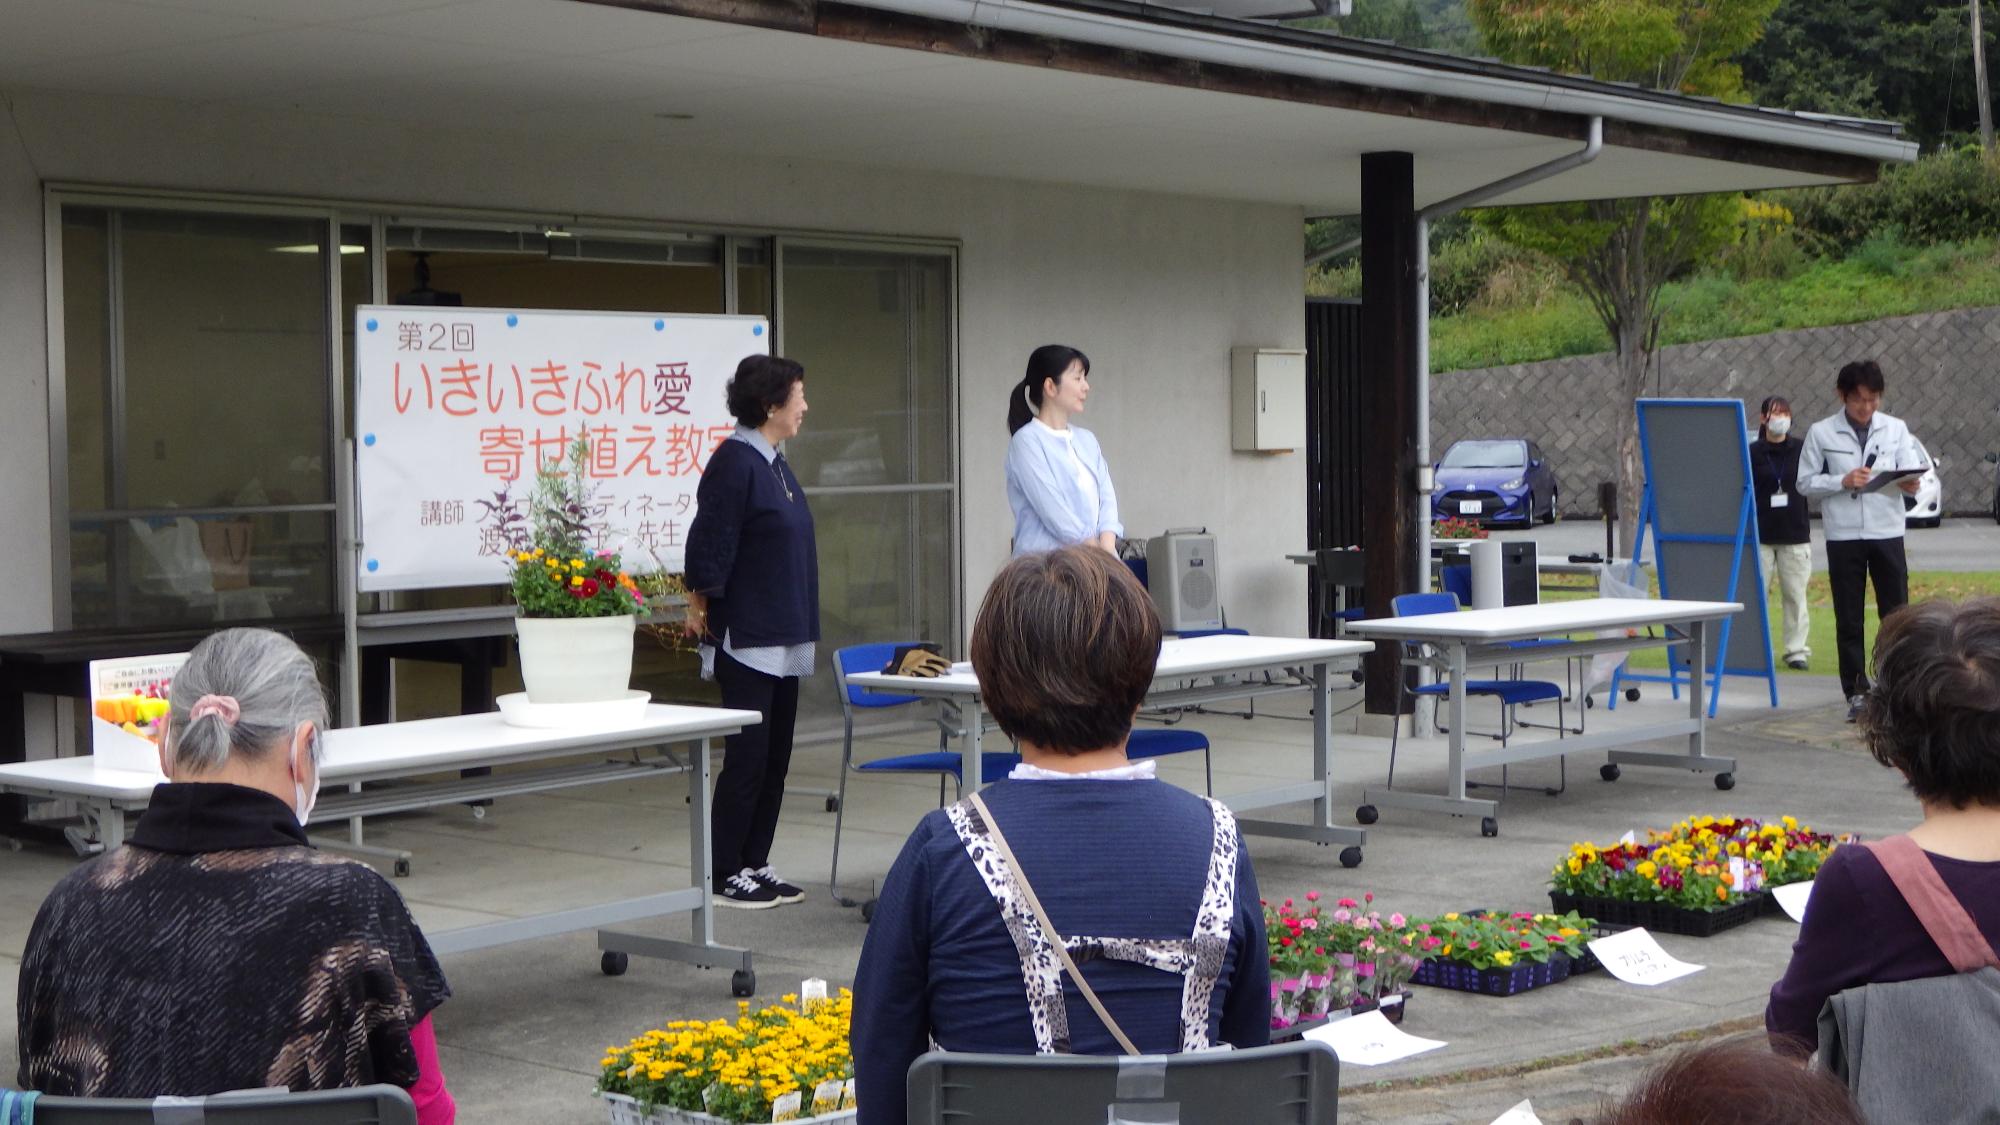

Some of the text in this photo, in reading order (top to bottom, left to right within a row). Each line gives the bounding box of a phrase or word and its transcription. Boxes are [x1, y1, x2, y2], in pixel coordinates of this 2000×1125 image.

[398, 321, 475, 352] 第2回
[393, 358, 692, 416] いきいきふれ愛
[420, 499, 464, 526] 講師
[637, 519, 683, 551] 先生
